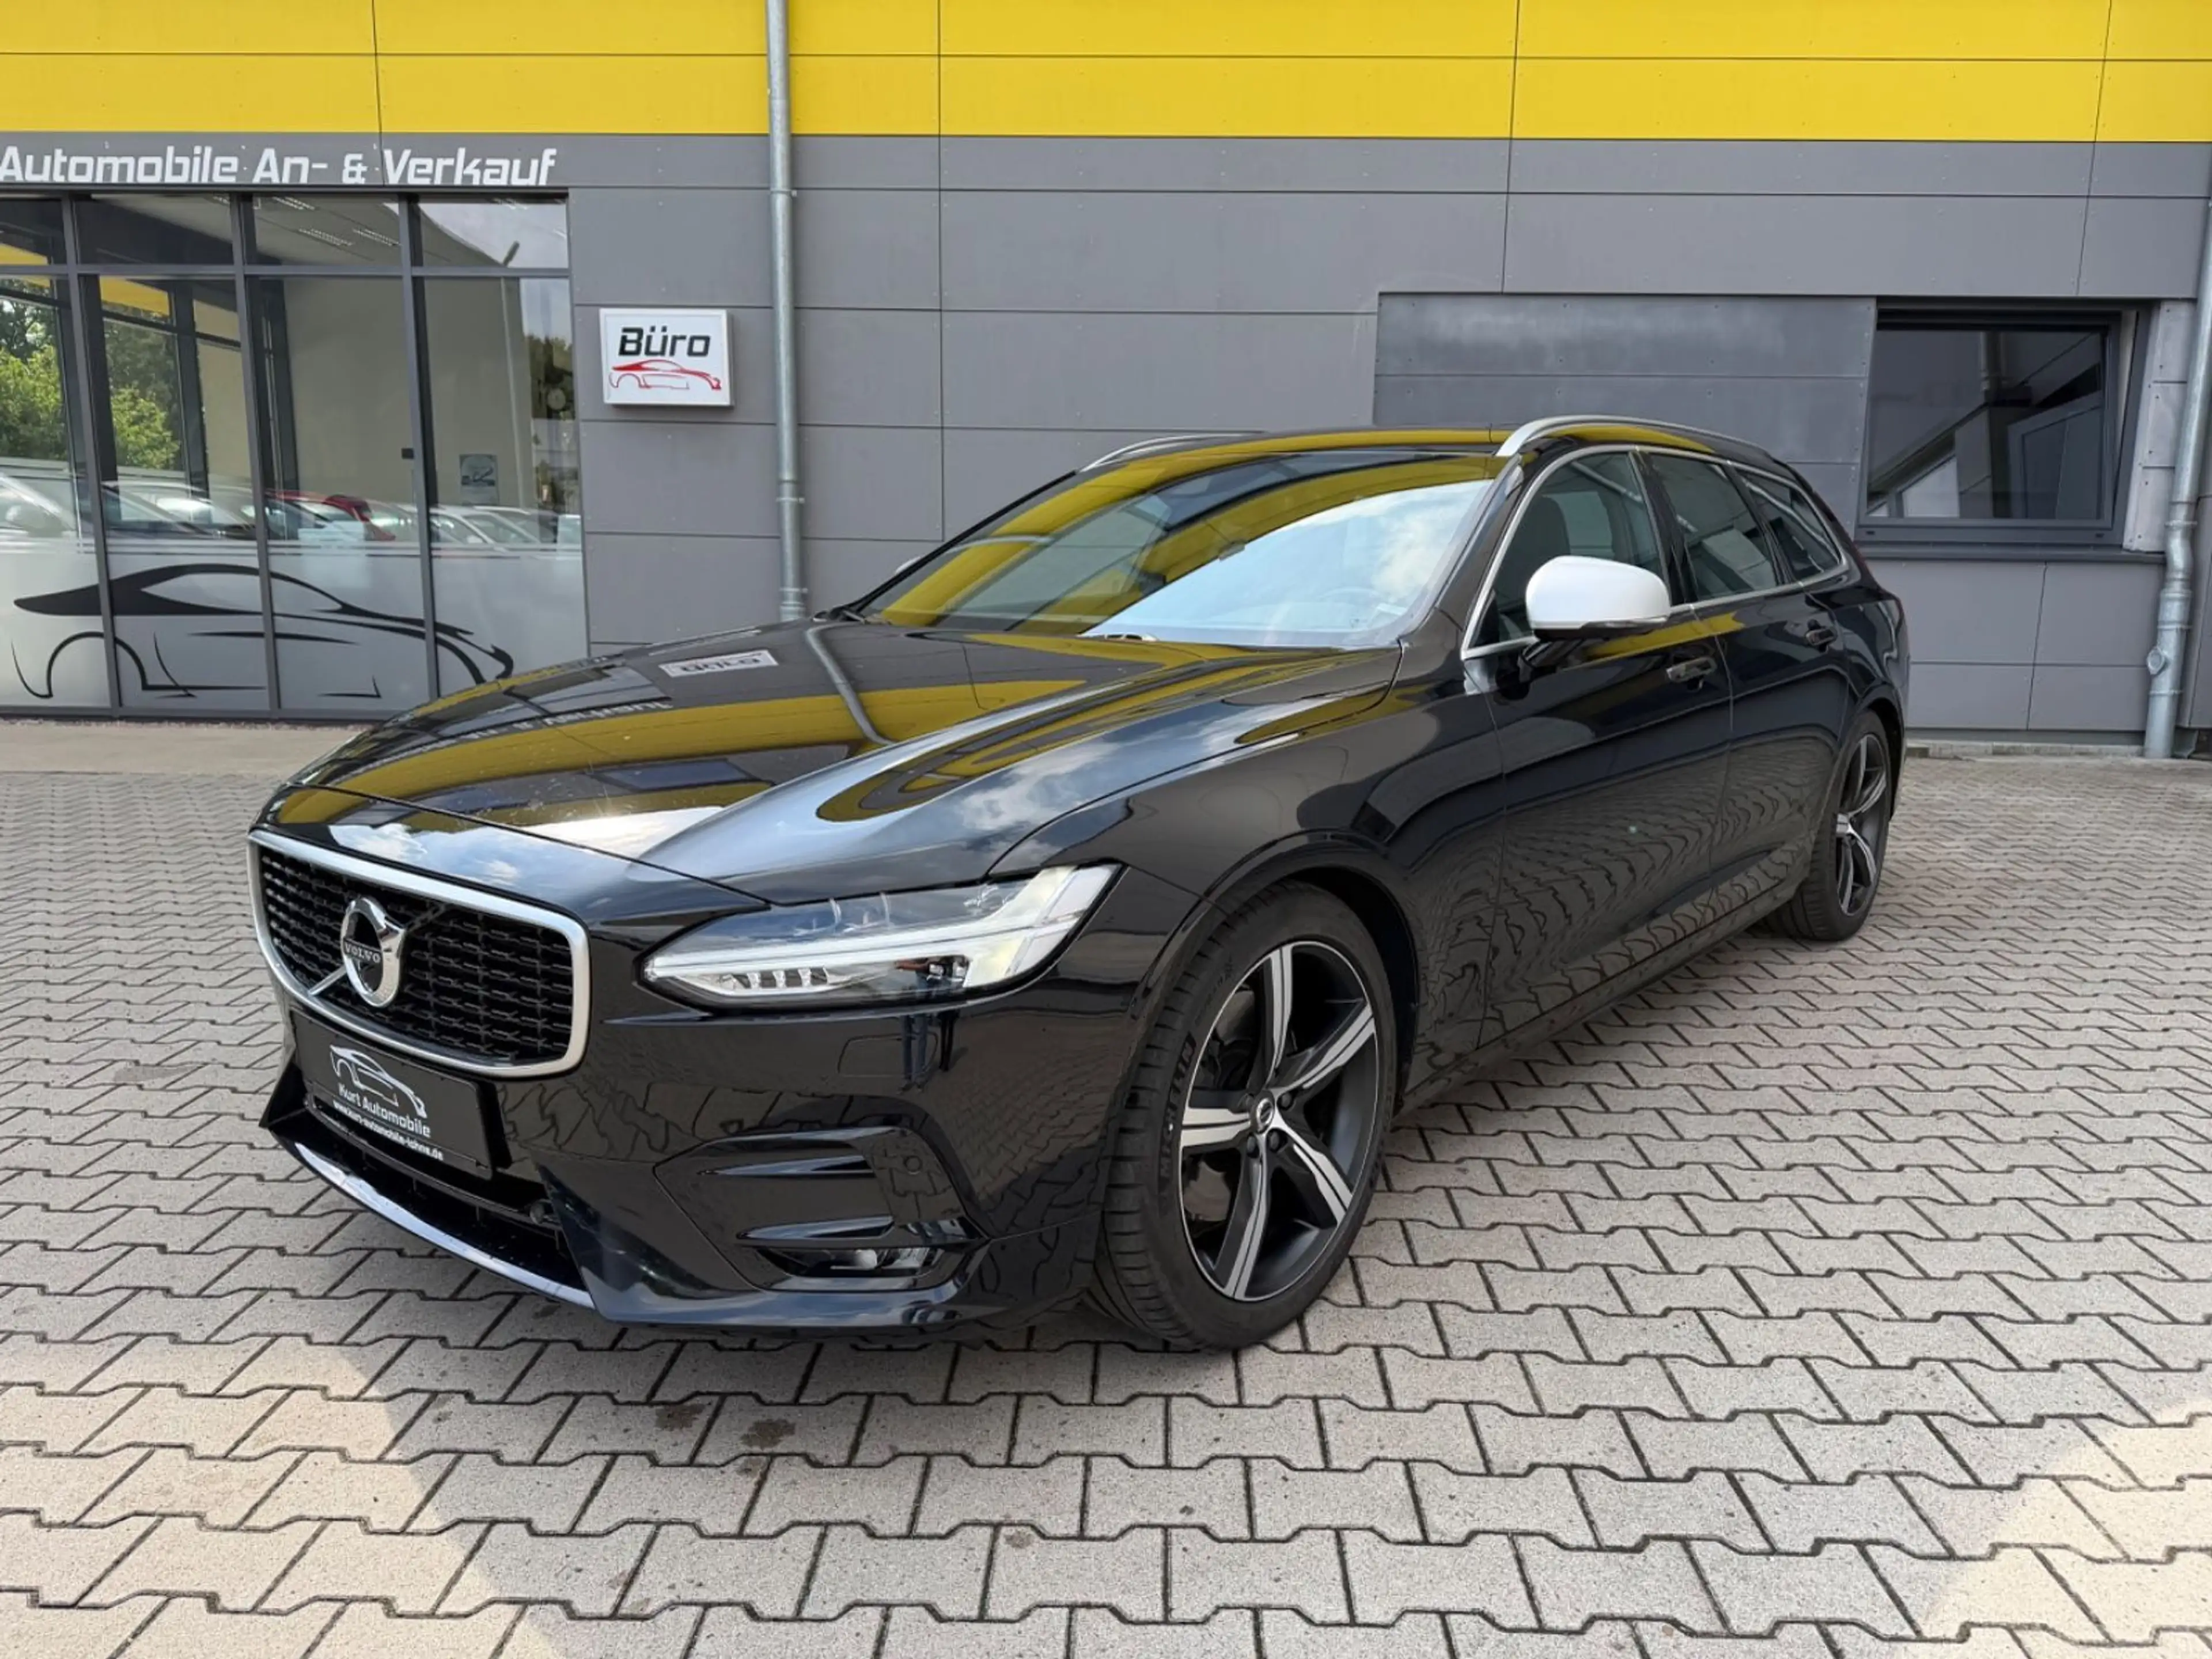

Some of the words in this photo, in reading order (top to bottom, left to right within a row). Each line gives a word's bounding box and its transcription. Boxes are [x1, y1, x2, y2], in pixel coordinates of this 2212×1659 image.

[0, 146, 239, 183] Automobile
[252, 147, 328, 184] An-
[342, 153, 368, 184] &
[383, 147, 557, 185] Verkauf
[618, 325, 711, 357] Büro
[345, 942, 381, 963] VOLVO
[362, 1096, 431, 1137] Automobile
